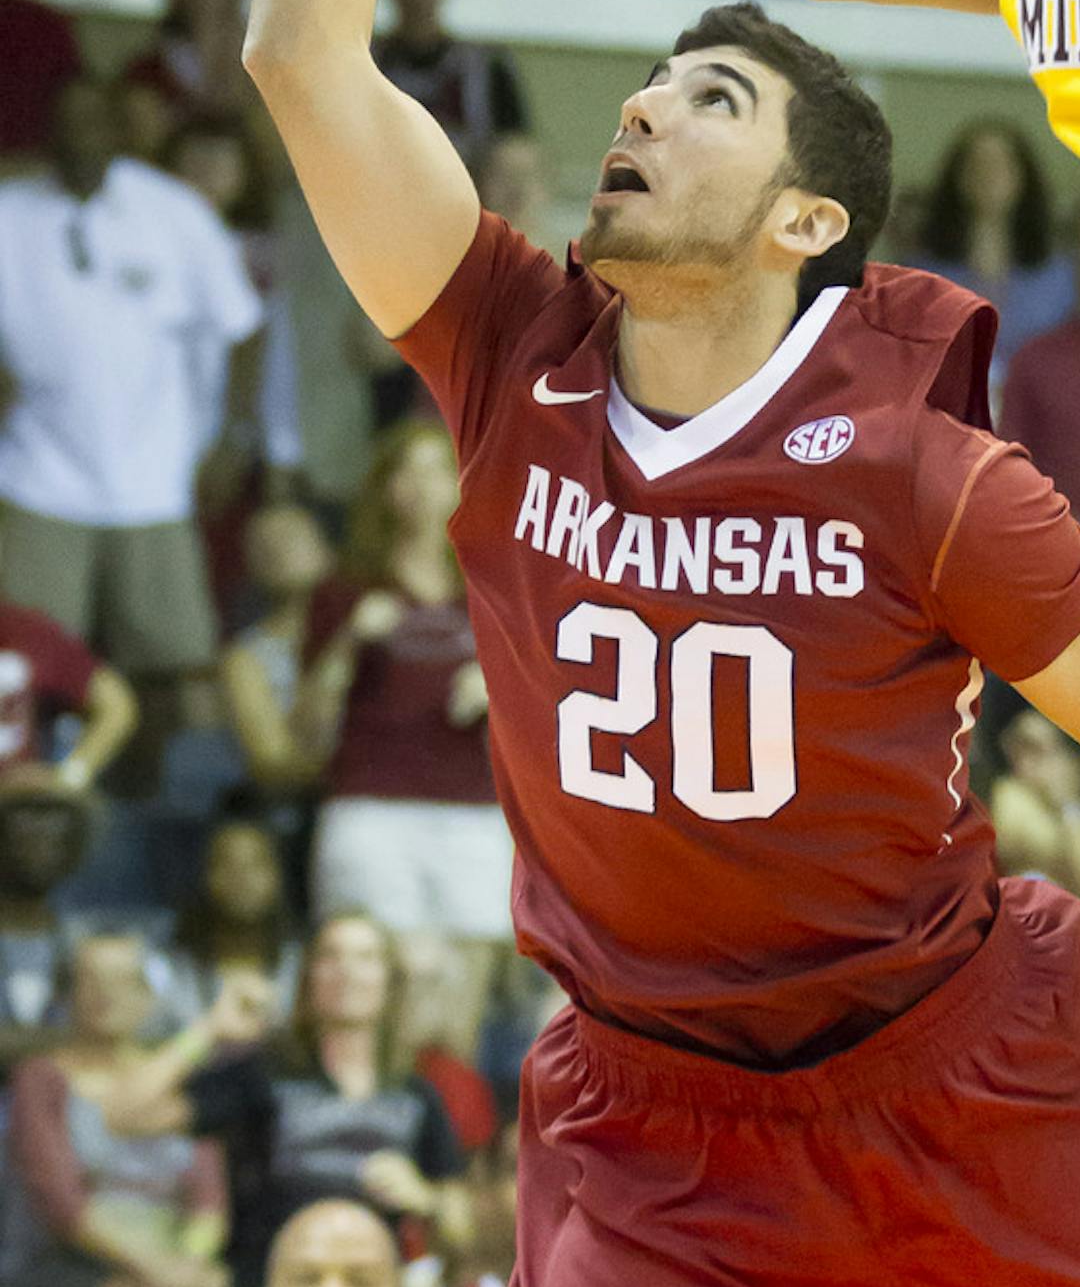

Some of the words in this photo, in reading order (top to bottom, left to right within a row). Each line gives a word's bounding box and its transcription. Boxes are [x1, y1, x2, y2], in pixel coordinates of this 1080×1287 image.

[787, 418, 851, 461] SEC
[513, 463, 865, 599] ARKANSAS
[555, 600, 797, 823] 20
